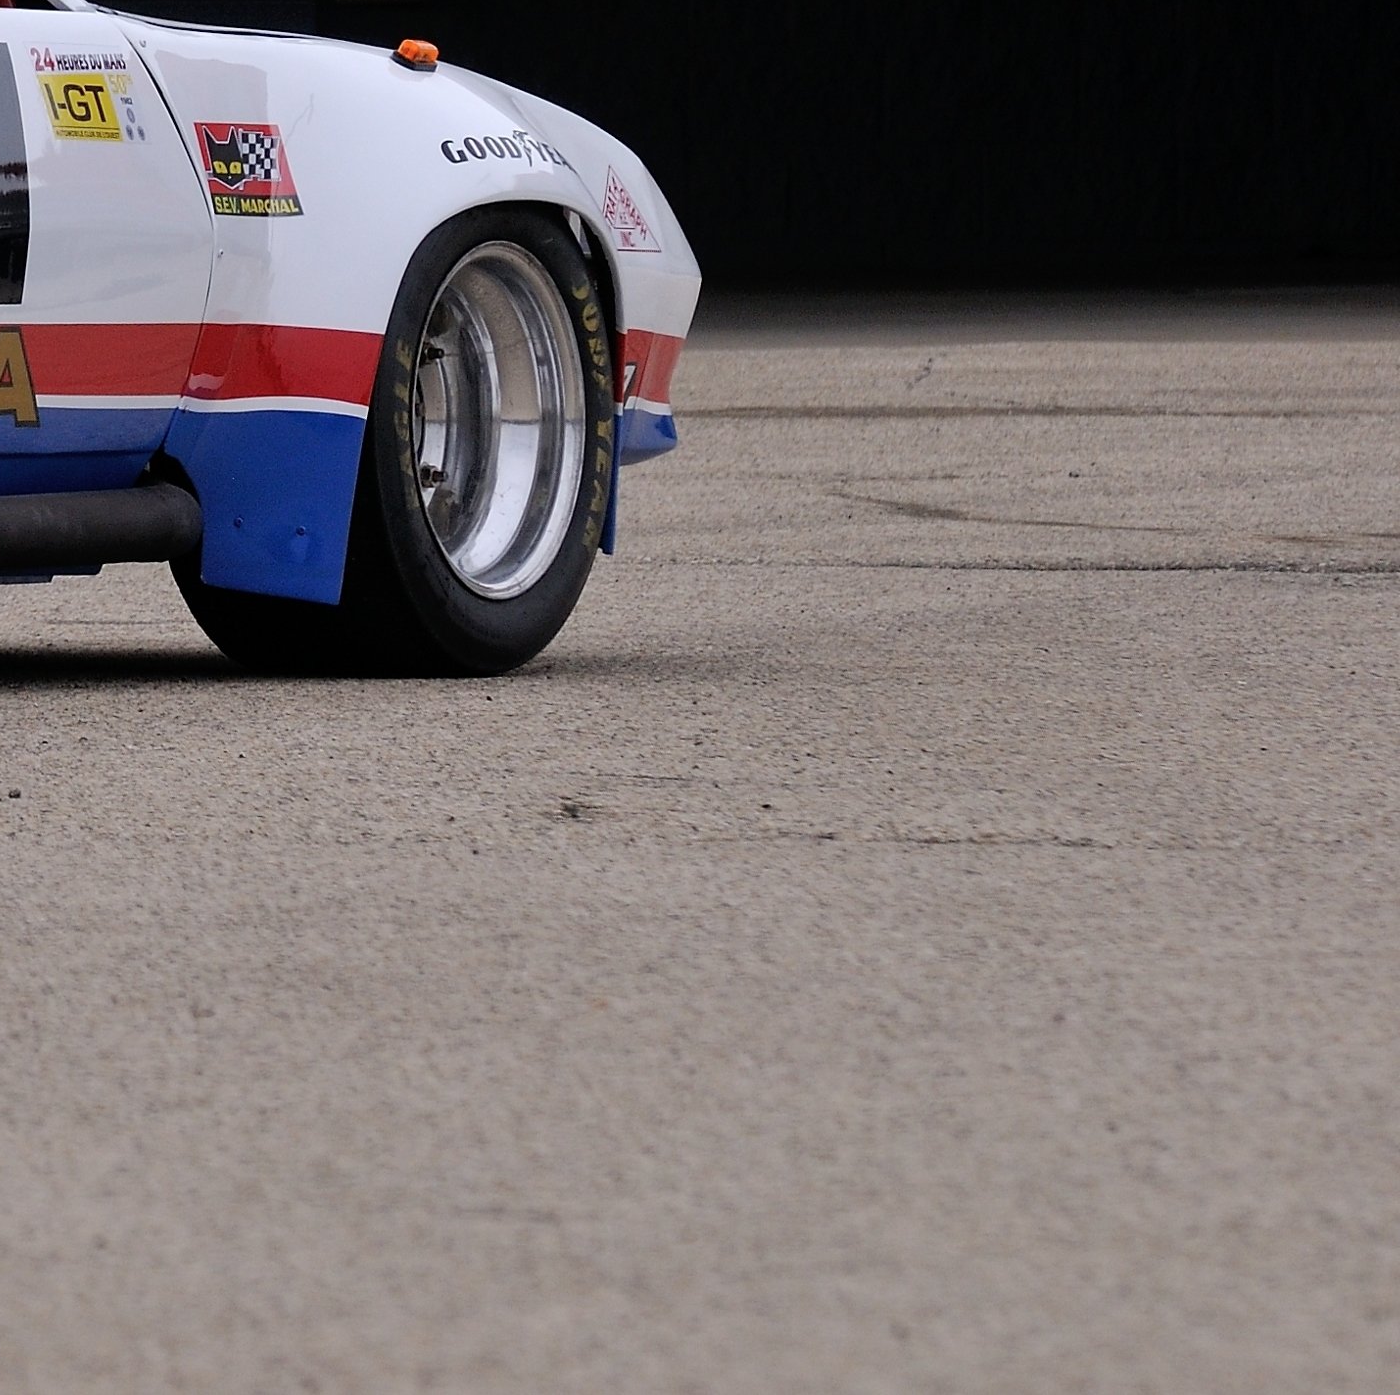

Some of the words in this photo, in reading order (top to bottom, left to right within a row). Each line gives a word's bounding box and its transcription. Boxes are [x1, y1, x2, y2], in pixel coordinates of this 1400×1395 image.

[30, 47, 55, 71] 24
[55, 54, 89, 71] HEURES
[89, 53, 103, 70] DU
[241, 198, 299, 214] MARCHAL
